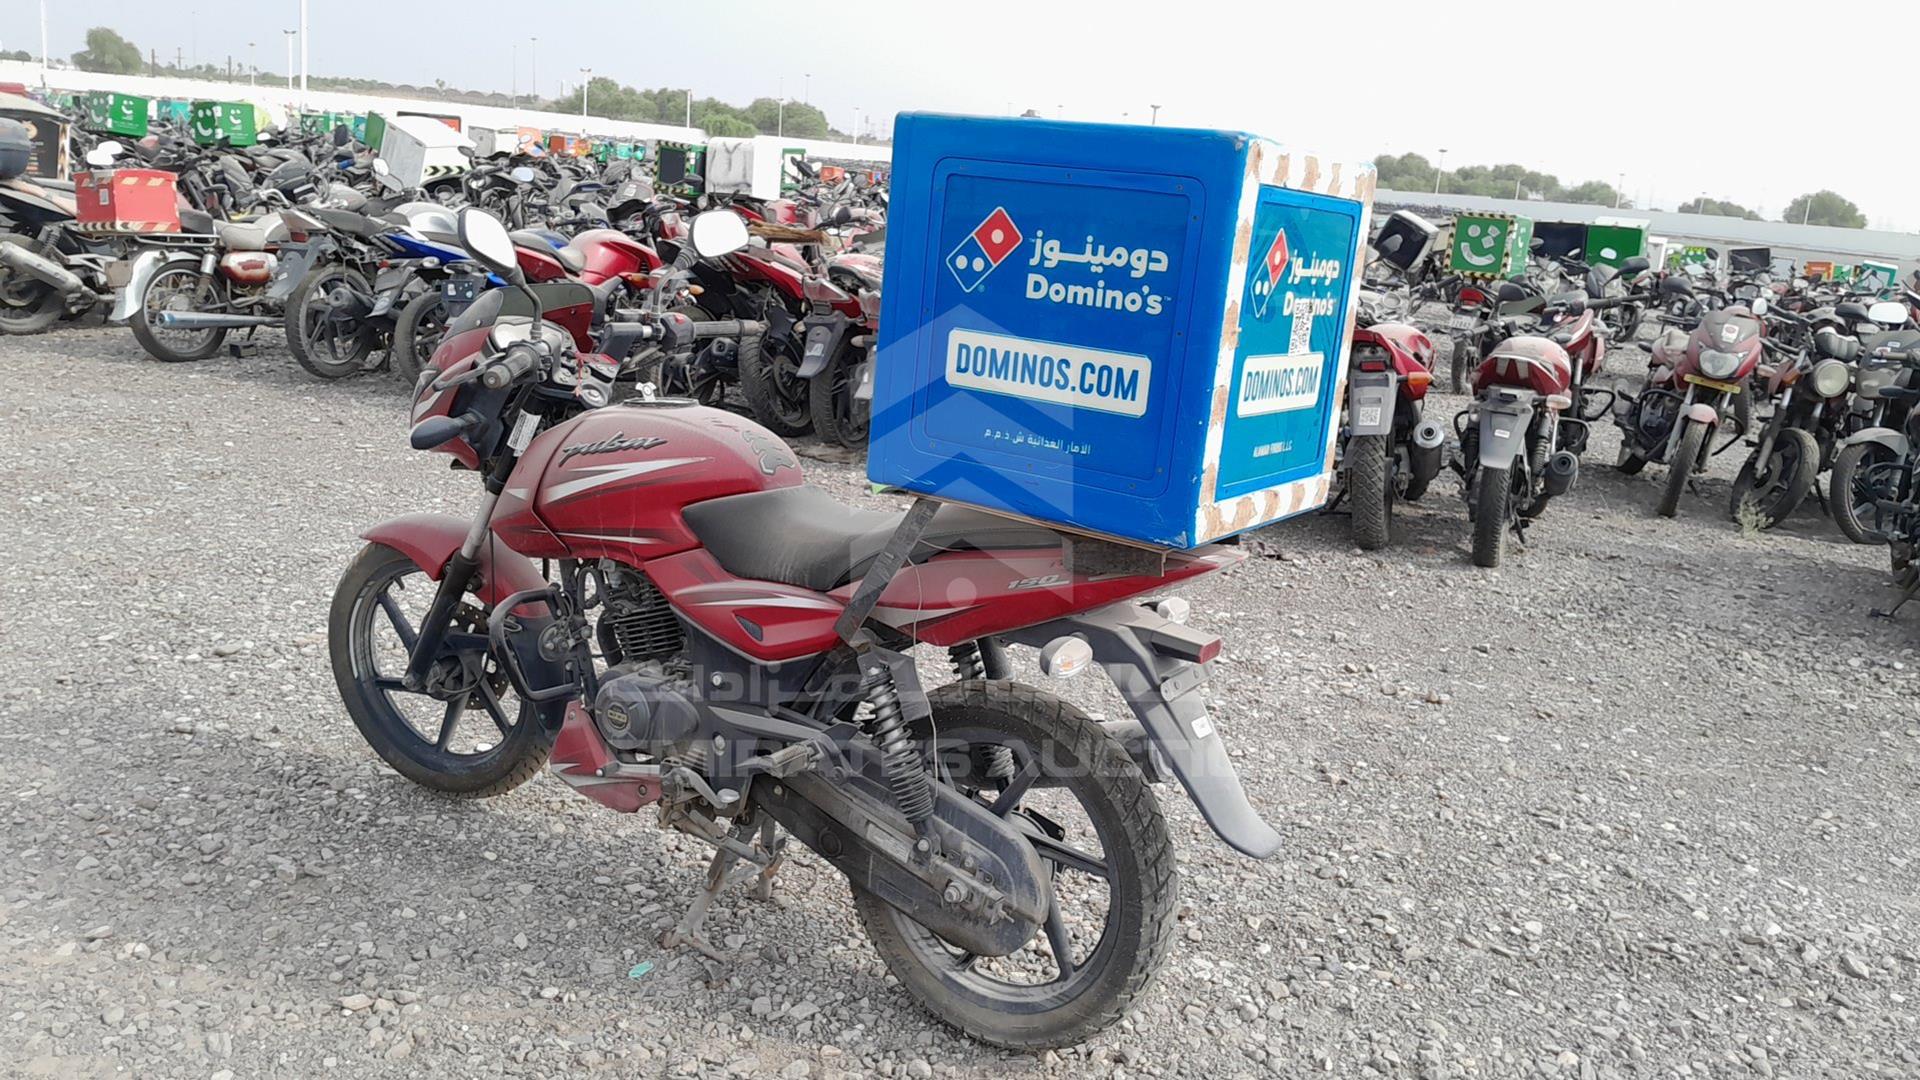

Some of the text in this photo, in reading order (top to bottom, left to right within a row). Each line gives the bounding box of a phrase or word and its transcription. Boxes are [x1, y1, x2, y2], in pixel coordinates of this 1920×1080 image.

[1029, 230, 1168, 278] دومينوز
[1026, 273, 1163, 315] Domino's
[1283, 291, 1333, 316] Dino's
[956, 343, 1139, 401] DOMINOS.COM
[1244, 366, 1319, 402] DOMINOS.COM
[1008, 574, 1060, 588] 150
